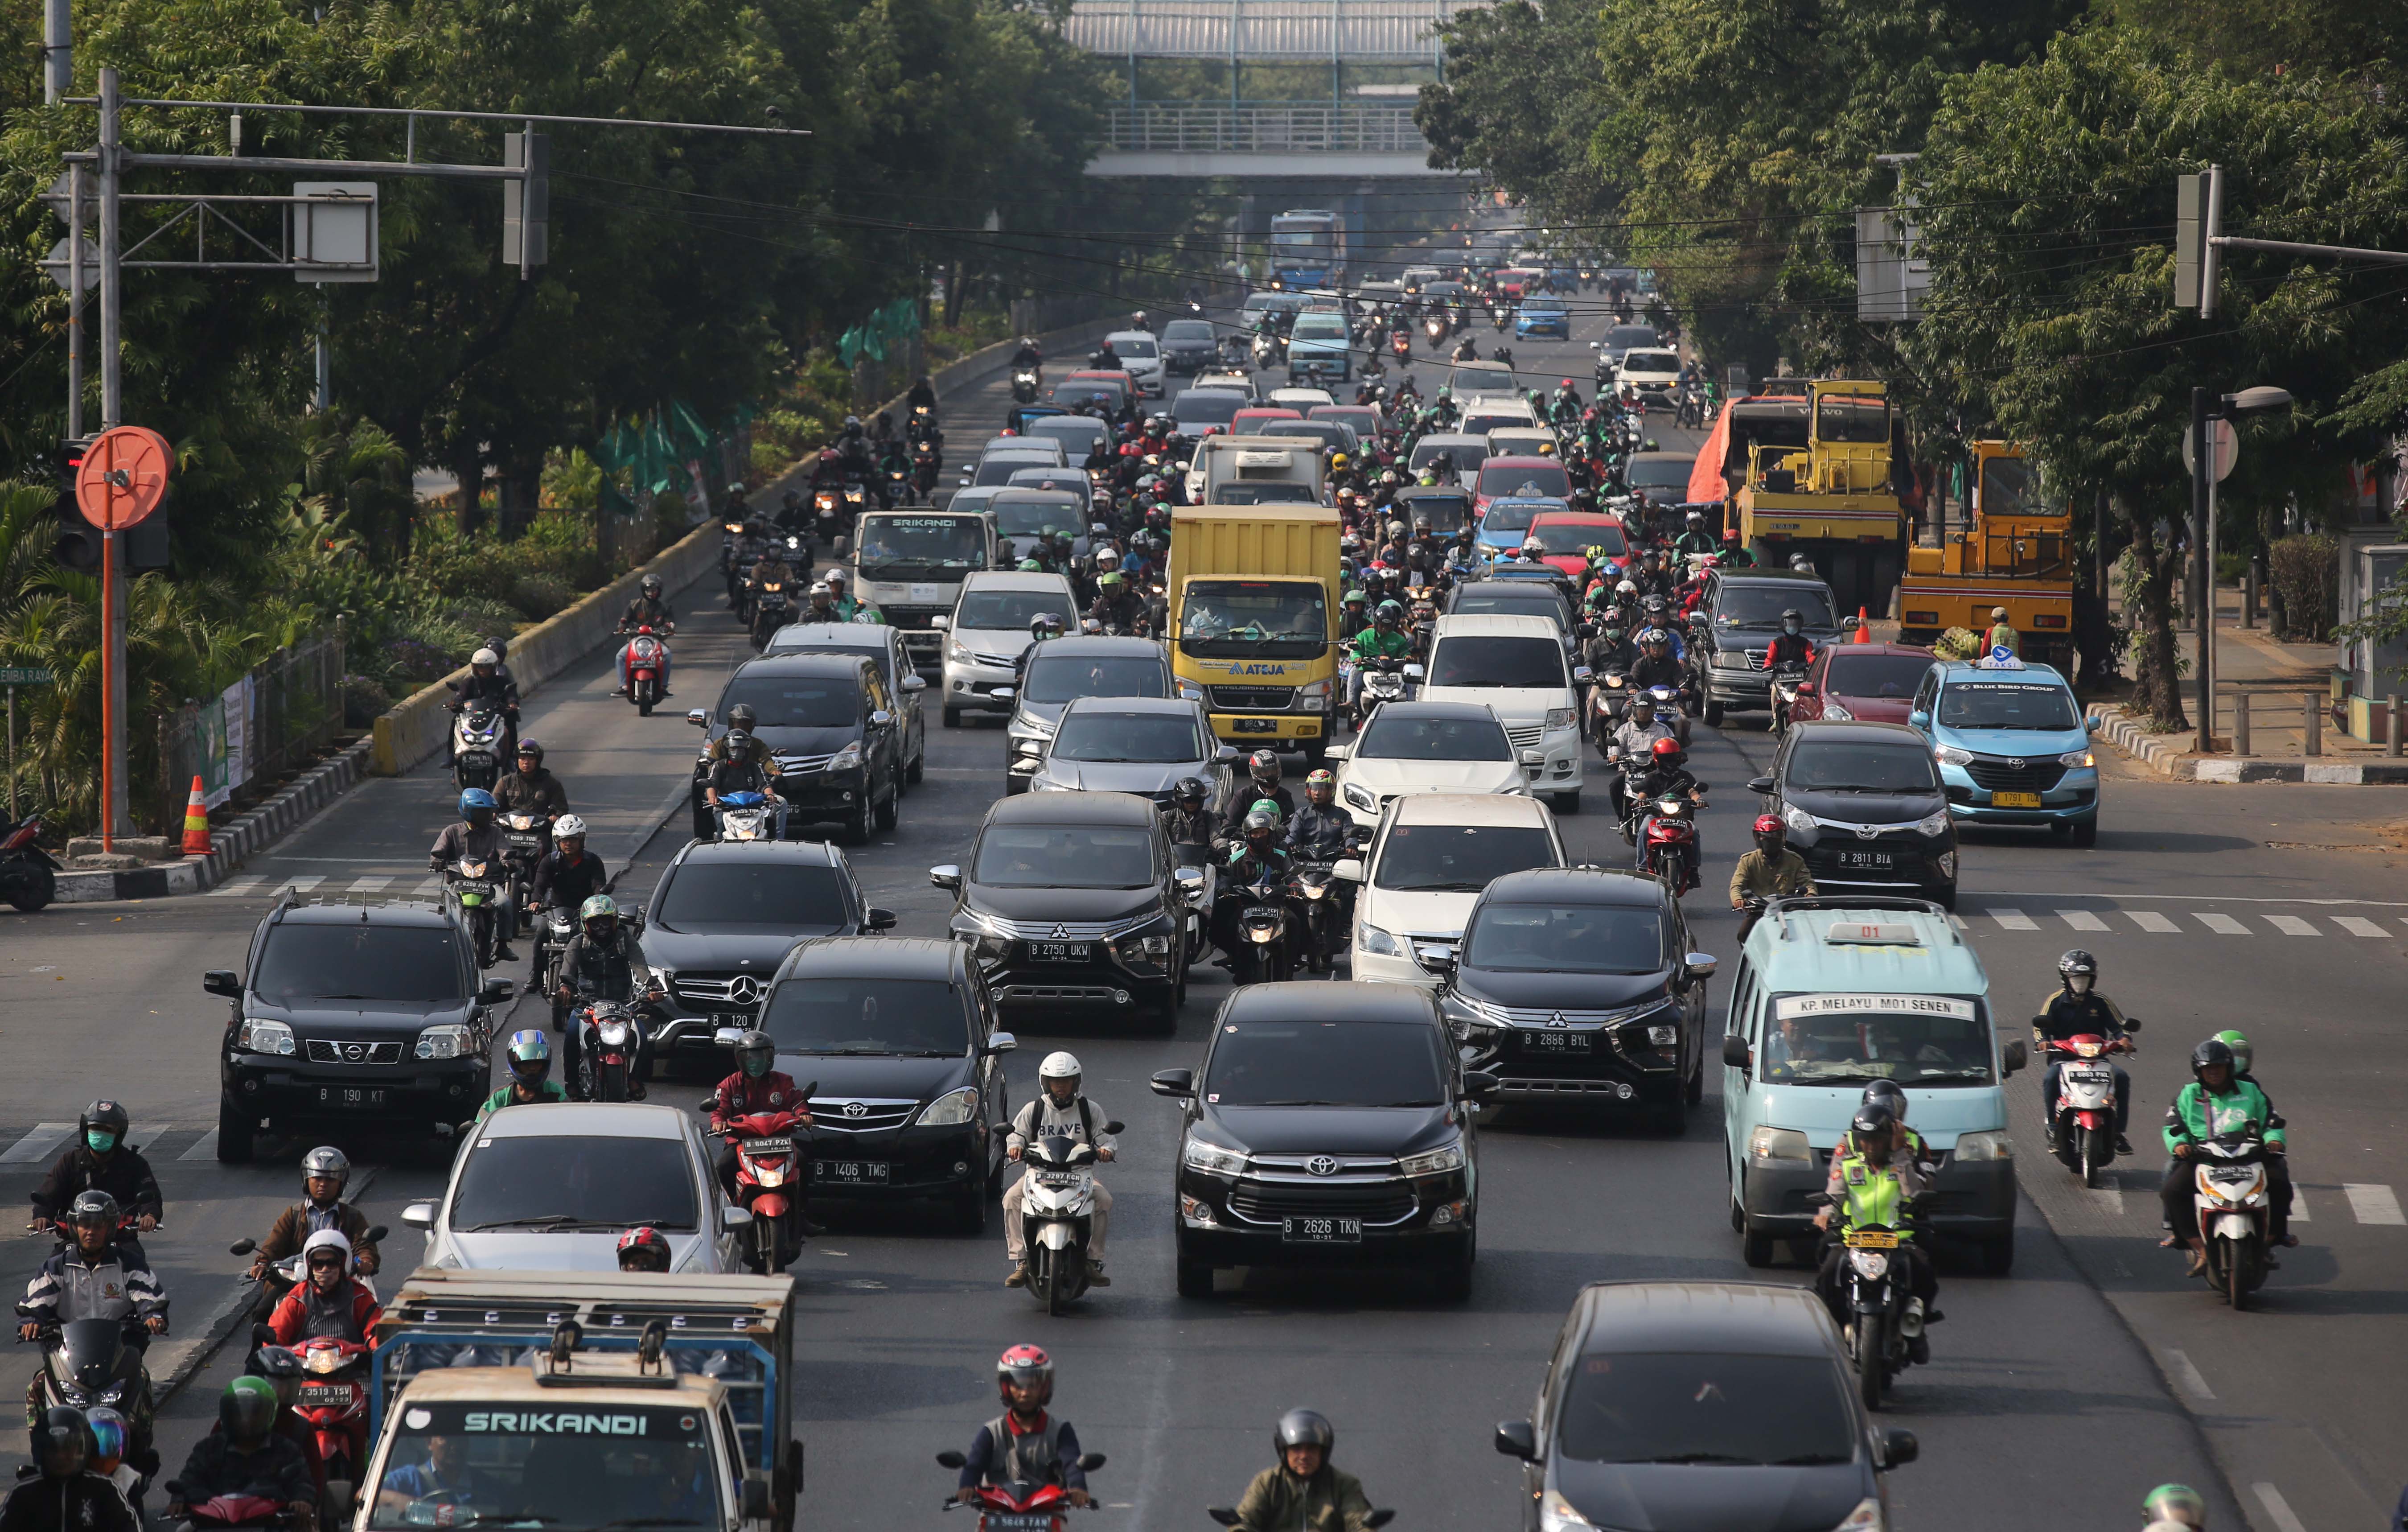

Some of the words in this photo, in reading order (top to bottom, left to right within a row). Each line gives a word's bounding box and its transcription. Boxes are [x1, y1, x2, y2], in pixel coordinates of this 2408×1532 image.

[1798, 408, 1843, 416] VVO
[1245, 664, 1285, 675] ATEJA
[0, 670, 25, 682] EMBA
[28, 670, 51, 682] RAYA
[1268, 719, 1276, 728] UC
[1993, 793, 1998, 801] B
[2005, 793, 2022, 802] 1791
[2027, 794, 2040, 802] TUA
[1841, 853, 1846, 862] B
[1852, 853, 1870, 862] 2811
[1877, 853, 1891, 864] BIA
[1861, 926, 1880, 938] 01
[1031, 944, 1038, 955] B
[1042, 945, 1065, 956] 2750
[1071, 945, 1089, 957] UKW
[1438, 984, 1444, 994] B
[1800, 1000, 1818, 1012] KP.
[1822, 997, 1872, 1010] MELAYU
[1880, 999, 1907, 1010] M01
[1911, 1000, 1952, 1013] SENEN
[713, 1014, 719, 1026] B
[731, 1014, 748, 1026] 120
[1525, 1033, 1531, 1045] B
[1540, 1033, 1564, 1046] 2886
[1571, 1034, 1588, 1046] BYL
[321, 1088, 326, 1100] B
[344, 1089, 360, 1101] 190
[371, 1090, 385, 1103] KT
[1040, 1123, 1081, 1136] BRAVE
[817, 1163, 823, 1176] B
[834, 1163, 859, 1177] 1406
[867, 1163, 886, 1178] TMG
[1285, 1220, 1292, 1233] B
[1304, 1220, 1331, 1234] 2626
[1340, 1220, 1360, 1235] TKN
[307, 1388, 329, 1396] 3519
[333, 1386, 350, 1396] TSV
[464, 1412, 647, 1436] SRIKANDI
[990, 1517, 996, 1526] B
